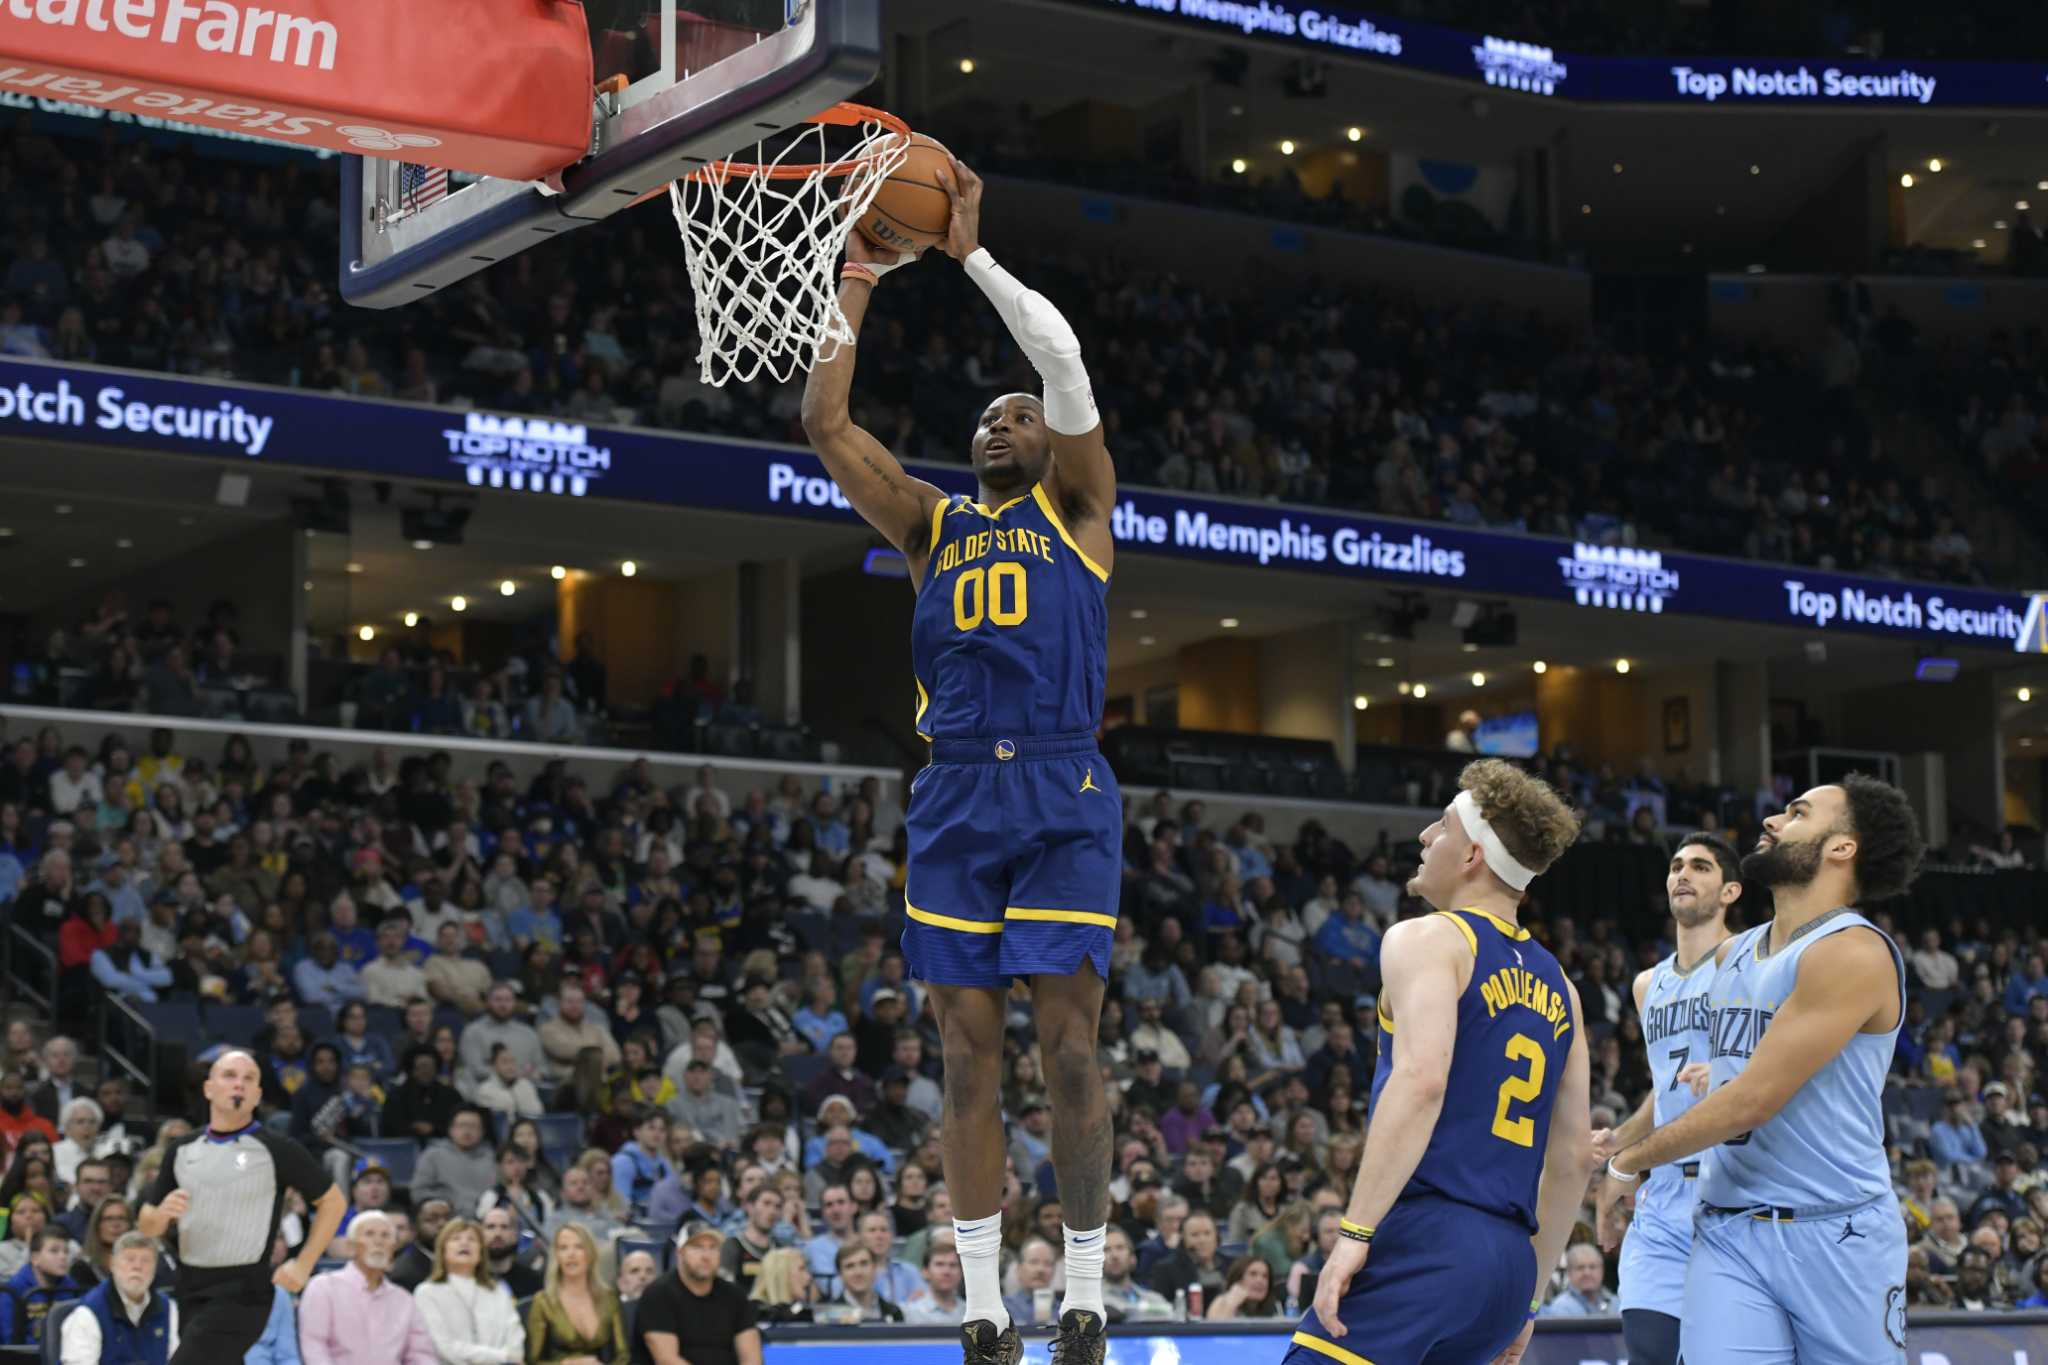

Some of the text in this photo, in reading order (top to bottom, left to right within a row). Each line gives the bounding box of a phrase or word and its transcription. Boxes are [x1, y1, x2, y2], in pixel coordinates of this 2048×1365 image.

[0, 0, 338, 70] ateFarm
[1299, 10, 1403, 56] Grizzlies
[0, 67, 333, 135] StateFar
[1671, 66, 1936, 103] Top Notch Security
[96, 387, 273, 455] Security
[442, 429, 509, 456] TOP
[935, 526, 1054, 579] GOLDE STATE
[1112, 501, 1168, 543] the
[1175, 510, 1326, 564] Memphis
[1333, 528, 1465, 577] Grizzlies
[953, 561, 1028, 632] 00
[1784, 580, 1837, 627] Top
[1841, 587, 1922, 629] Notch
[1647, 992, 1711, 1045] GRIZZLIES
[1491, 1032, 1547, 1148] 2
[1668, 1046, 1691, 1092] 7
